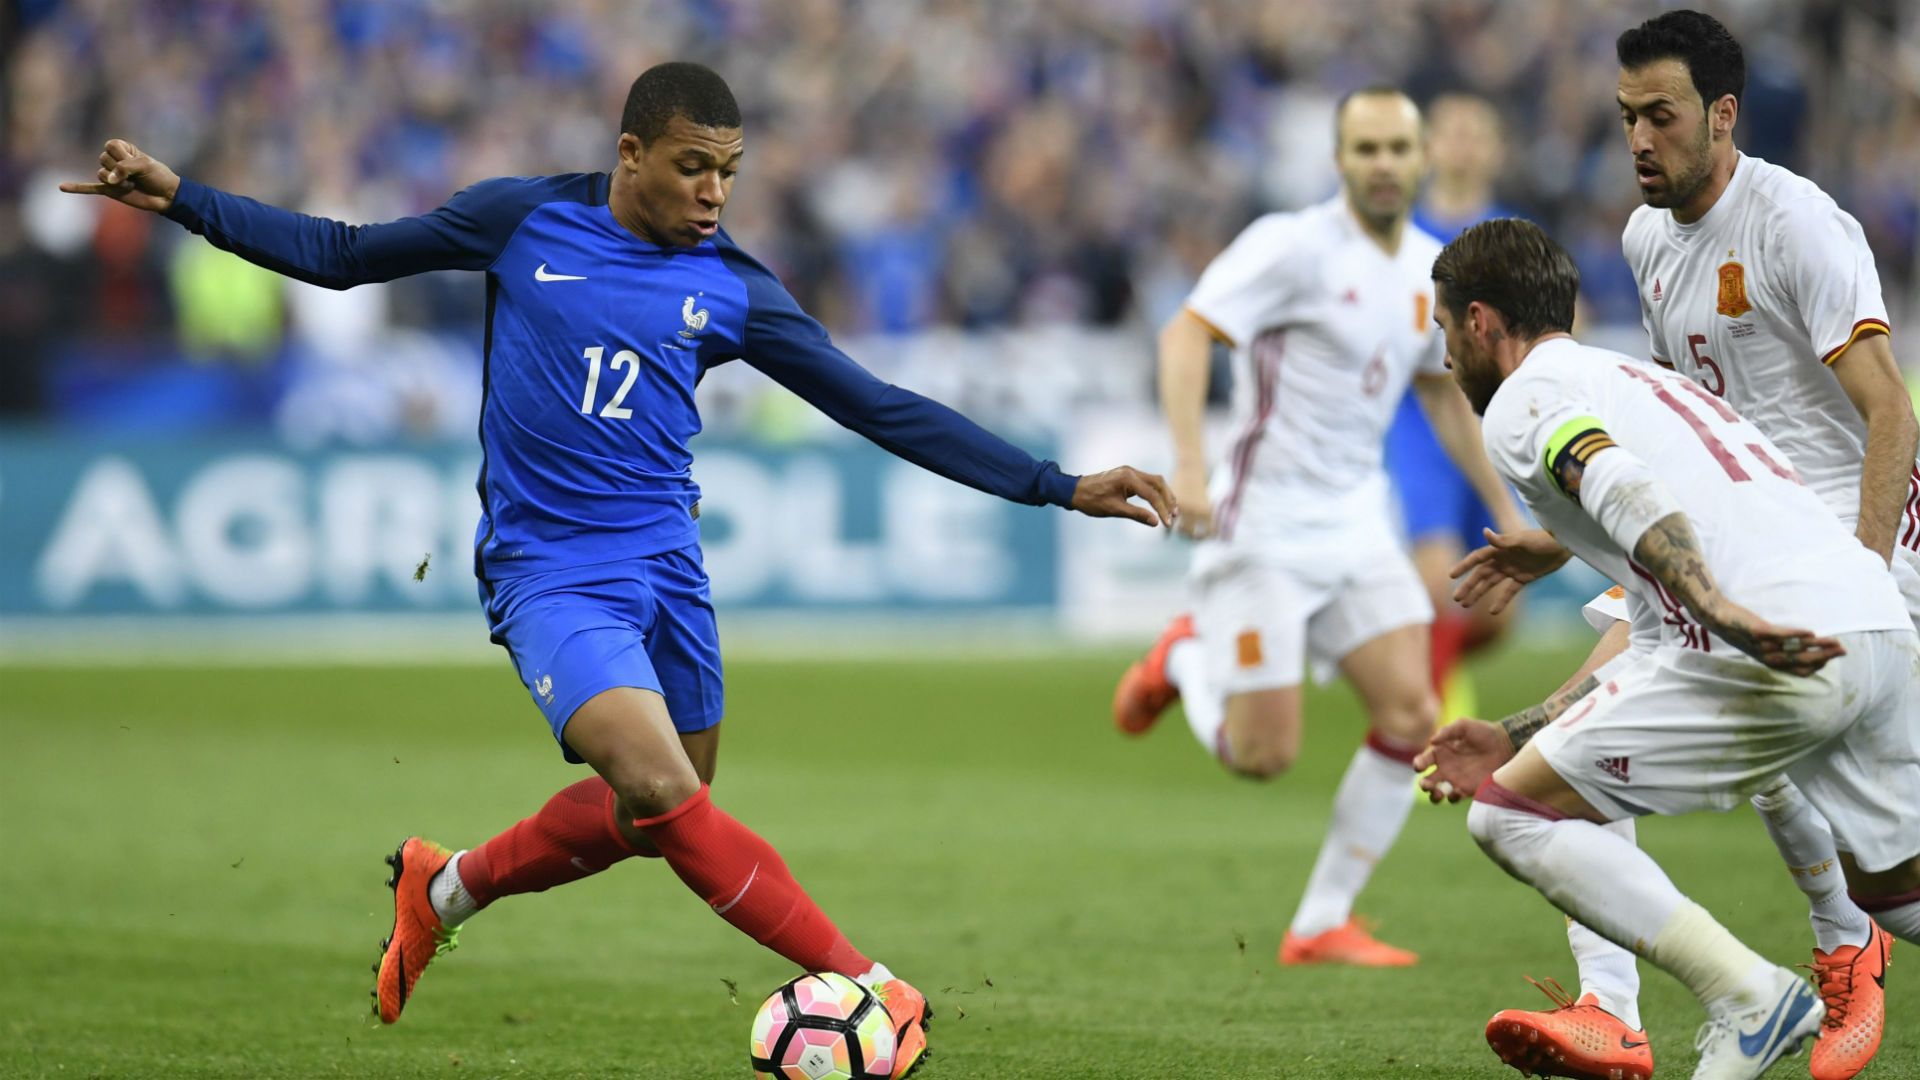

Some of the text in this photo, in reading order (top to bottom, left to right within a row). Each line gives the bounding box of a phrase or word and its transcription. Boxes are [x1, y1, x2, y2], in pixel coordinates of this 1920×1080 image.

[581, 346, 641, 420] 12
[1687, 333, 1725, 398] 5
[35, 456, 1006, 604] AGRIOLE
